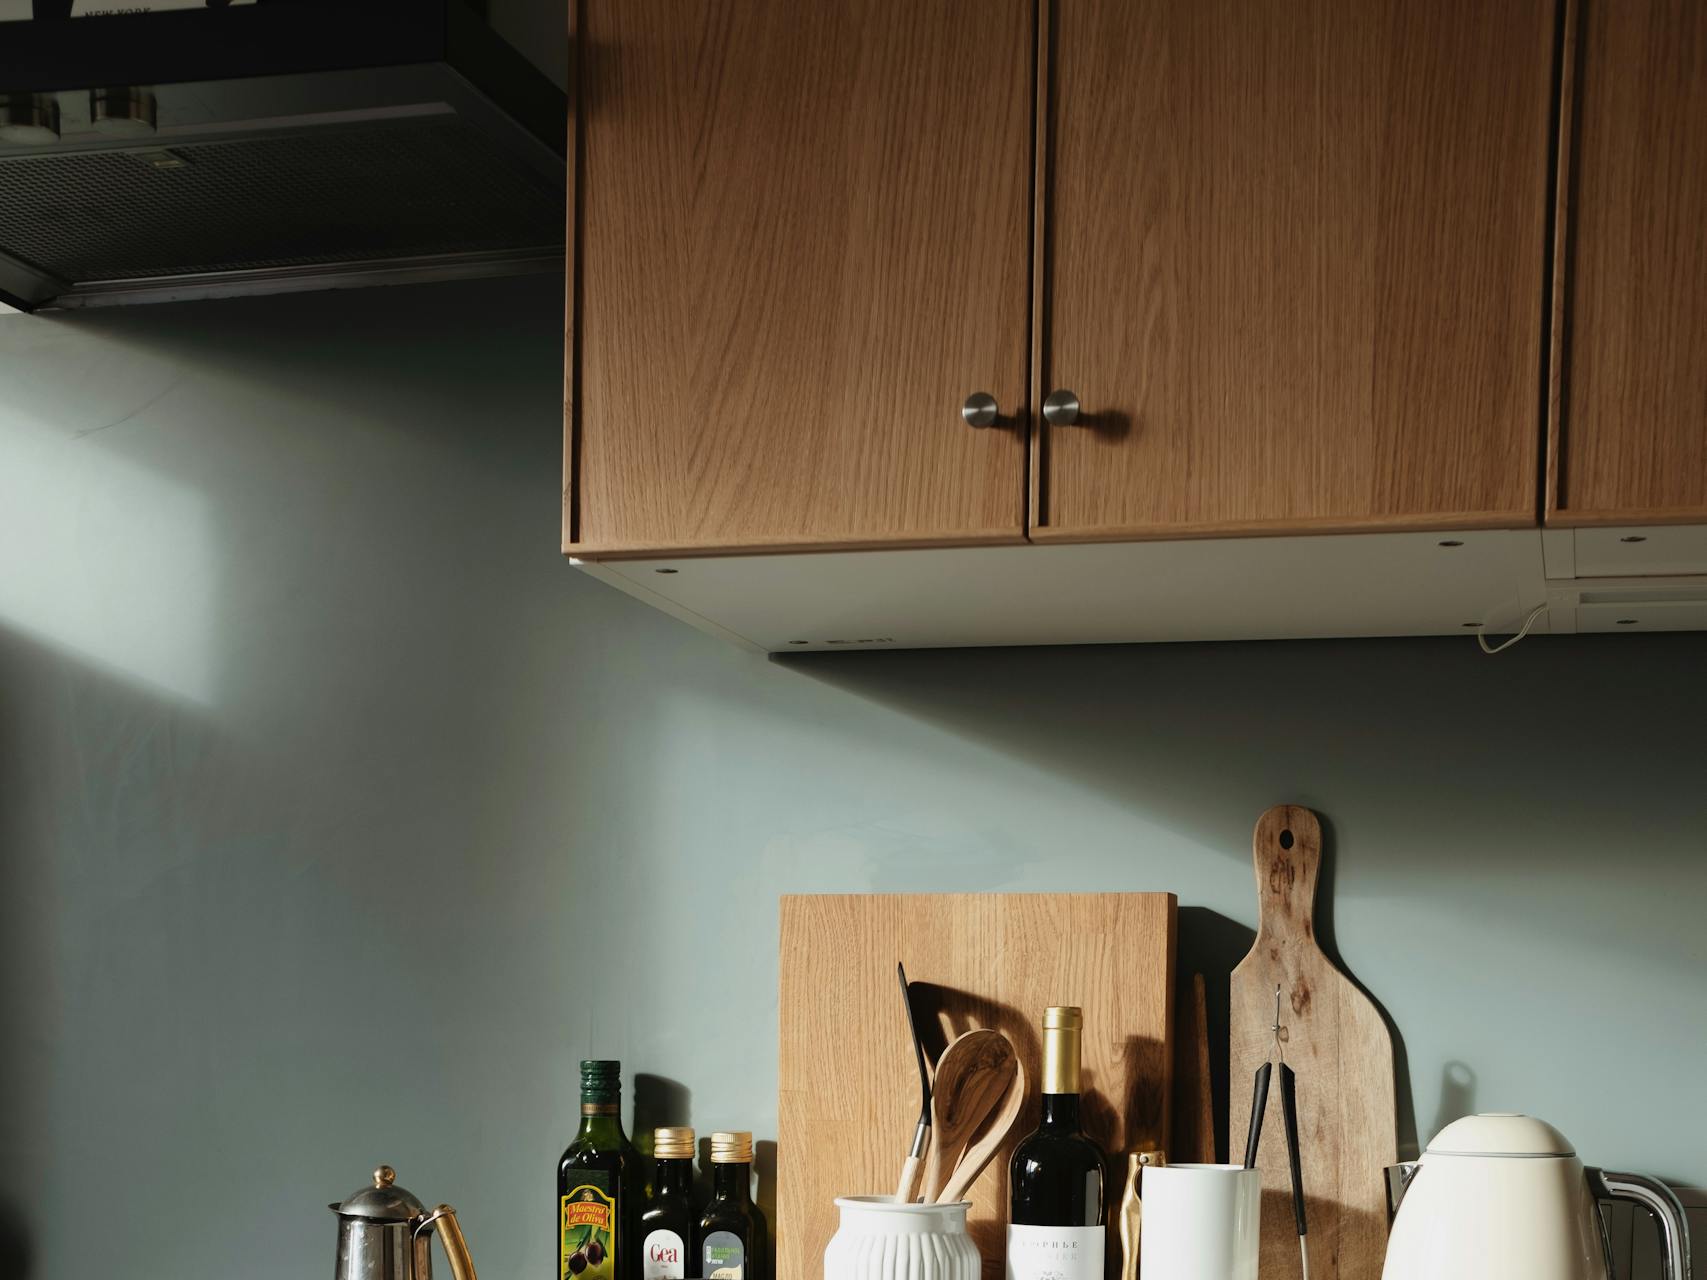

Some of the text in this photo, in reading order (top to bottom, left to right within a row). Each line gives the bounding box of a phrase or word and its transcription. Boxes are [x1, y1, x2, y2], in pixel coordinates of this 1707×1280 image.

[570, 1204, 606, 1214] Maestro
[570, 1213, 604, 1225] de Oliva
